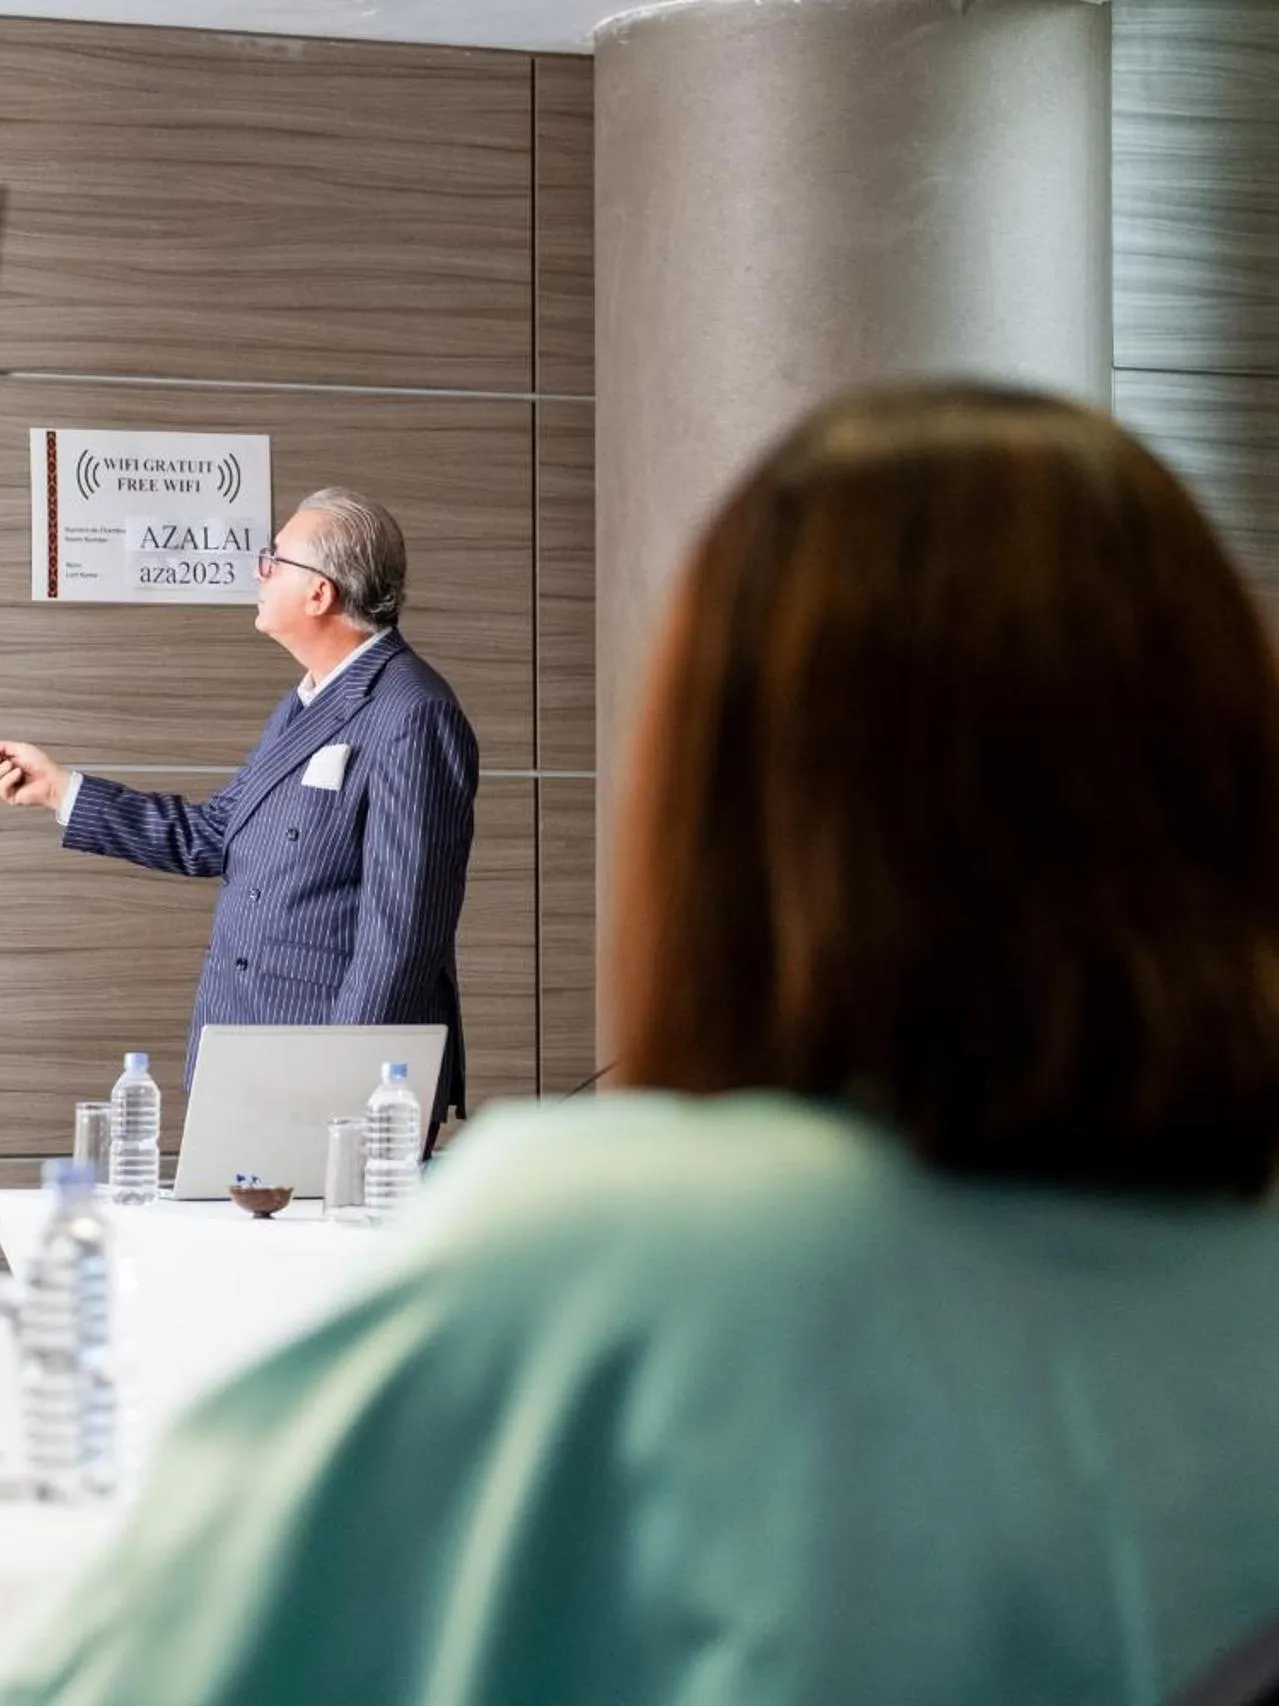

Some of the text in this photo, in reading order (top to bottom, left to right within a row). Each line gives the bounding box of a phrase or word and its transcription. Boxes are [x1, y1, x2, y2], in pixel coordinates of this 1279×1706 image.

[104, 457, 212, 475] WIFI GRATUIT
[117, 477, 201, 494] FREE WIFI
[139, 524, 252, 551] AZALAI
[139, 560, 236, 585] aza2023
